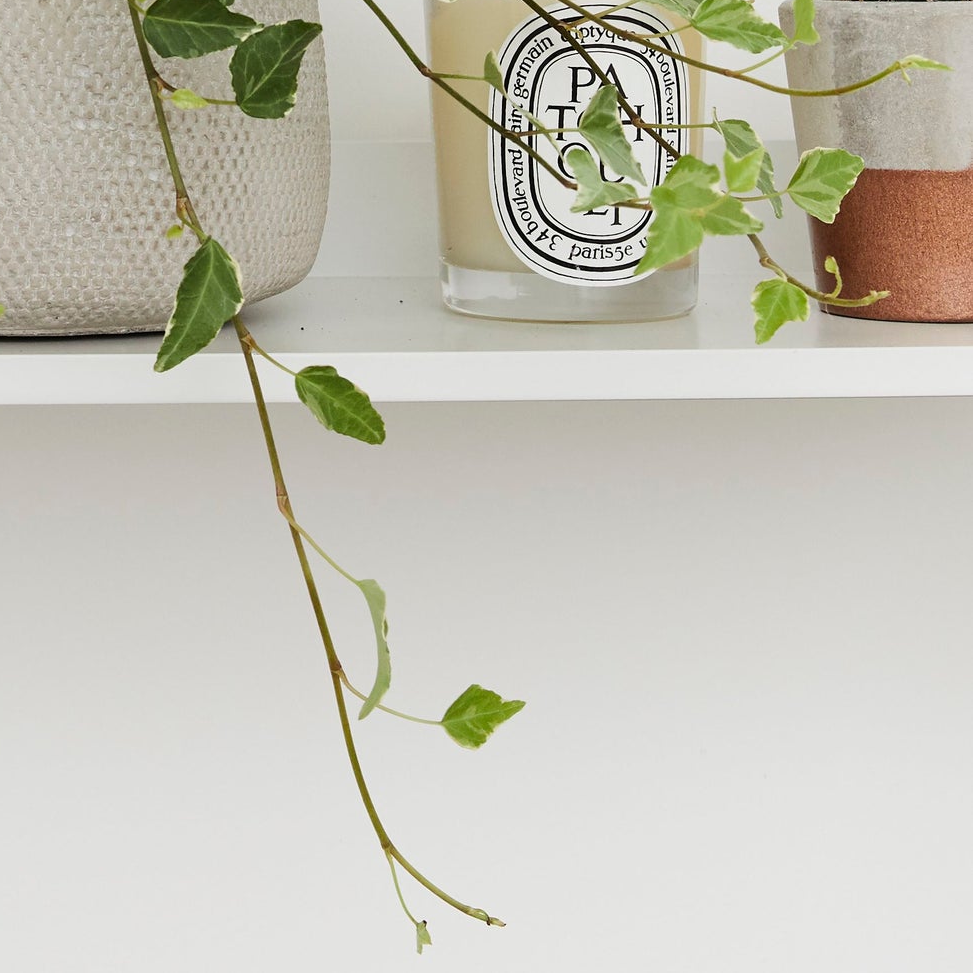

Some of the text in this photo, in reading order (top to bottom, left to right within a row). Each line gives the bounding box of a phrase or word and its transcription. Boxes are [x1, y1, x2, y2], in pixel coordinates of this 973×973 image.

[513, 35, 555, 100] germain
[545, 104, 645, 143] TH
[508, 148, 539, 236] boulevard
[567, 243, 634, 262] paris5e
